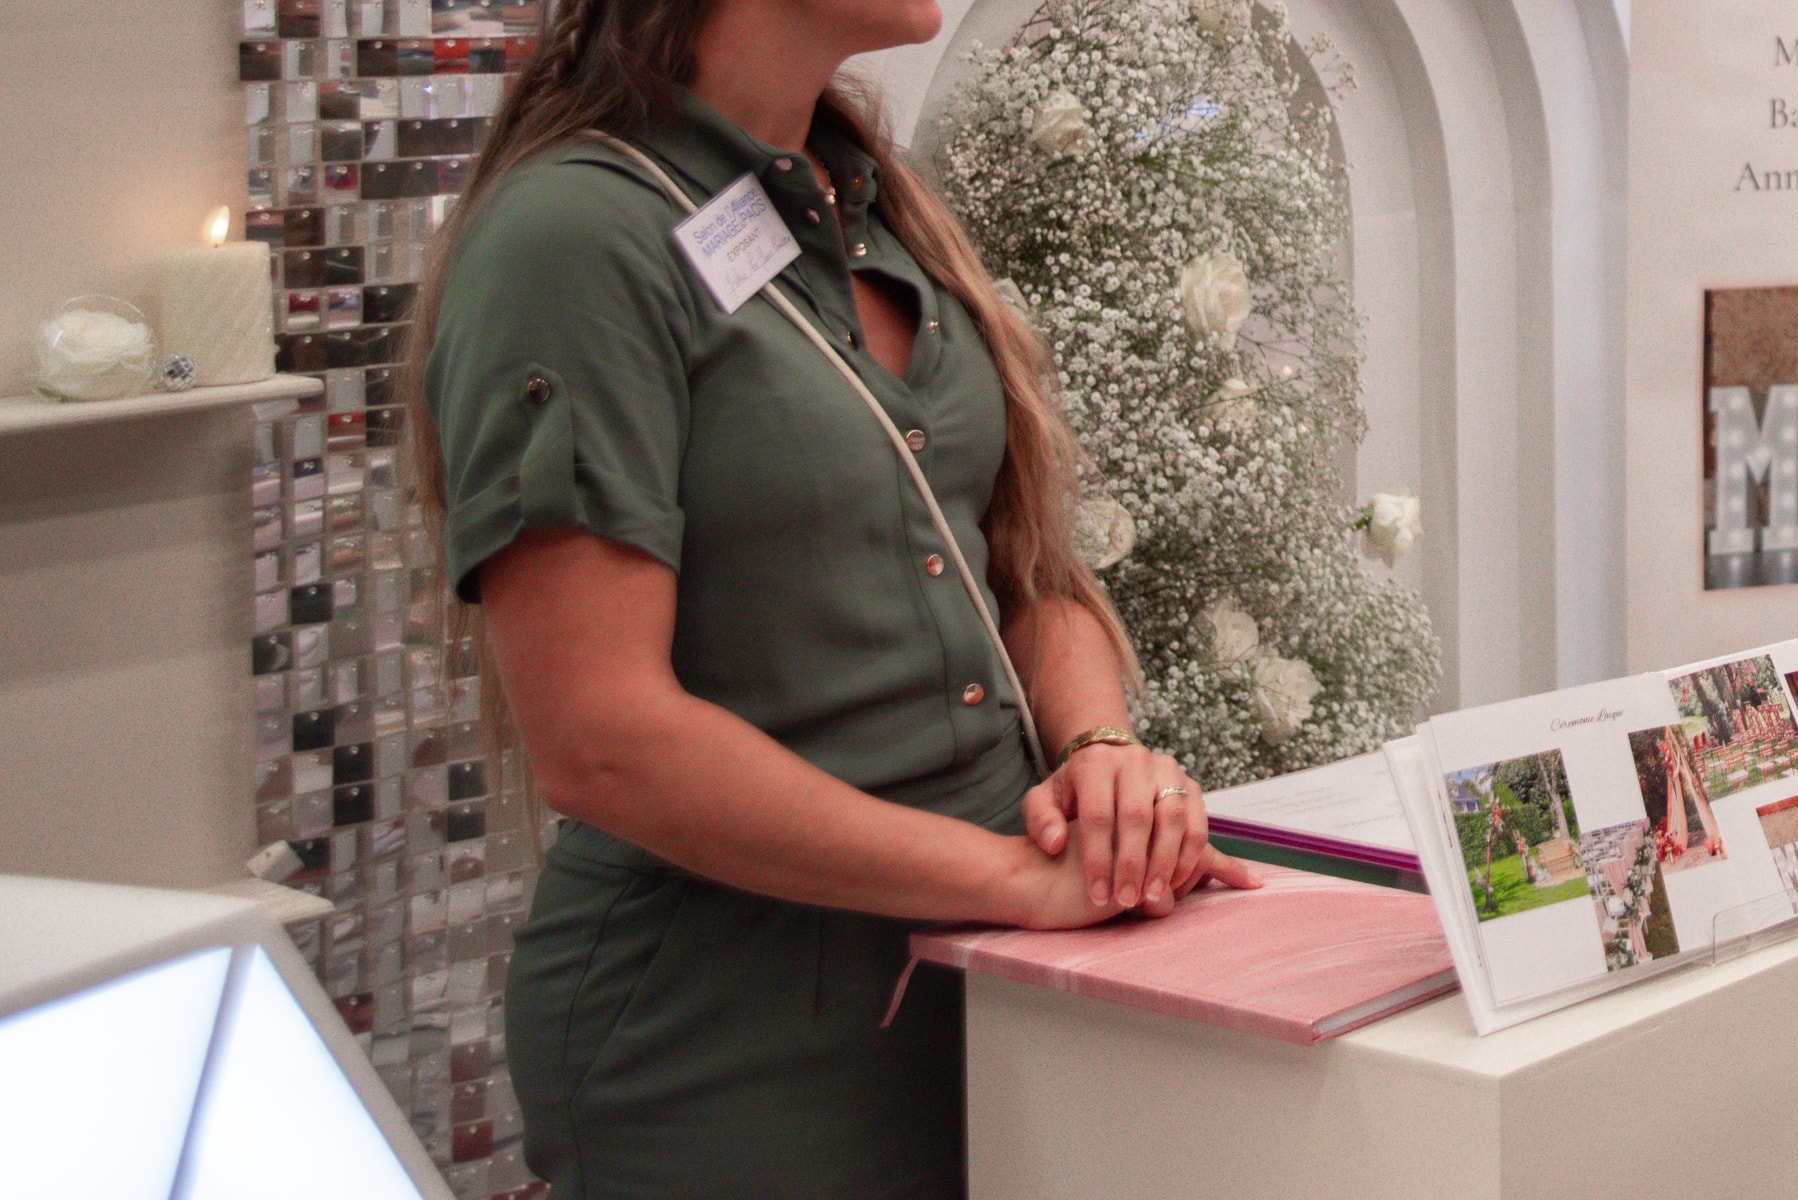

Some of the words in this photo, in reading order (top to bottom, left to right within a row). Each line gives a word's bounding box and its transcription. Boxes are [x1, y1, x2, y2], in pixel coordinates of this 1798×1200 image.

[693, 219, 718, 245] Salon
[715, 212, 728, 227] de
[726, 226, 762, 263] EXPOSANT
